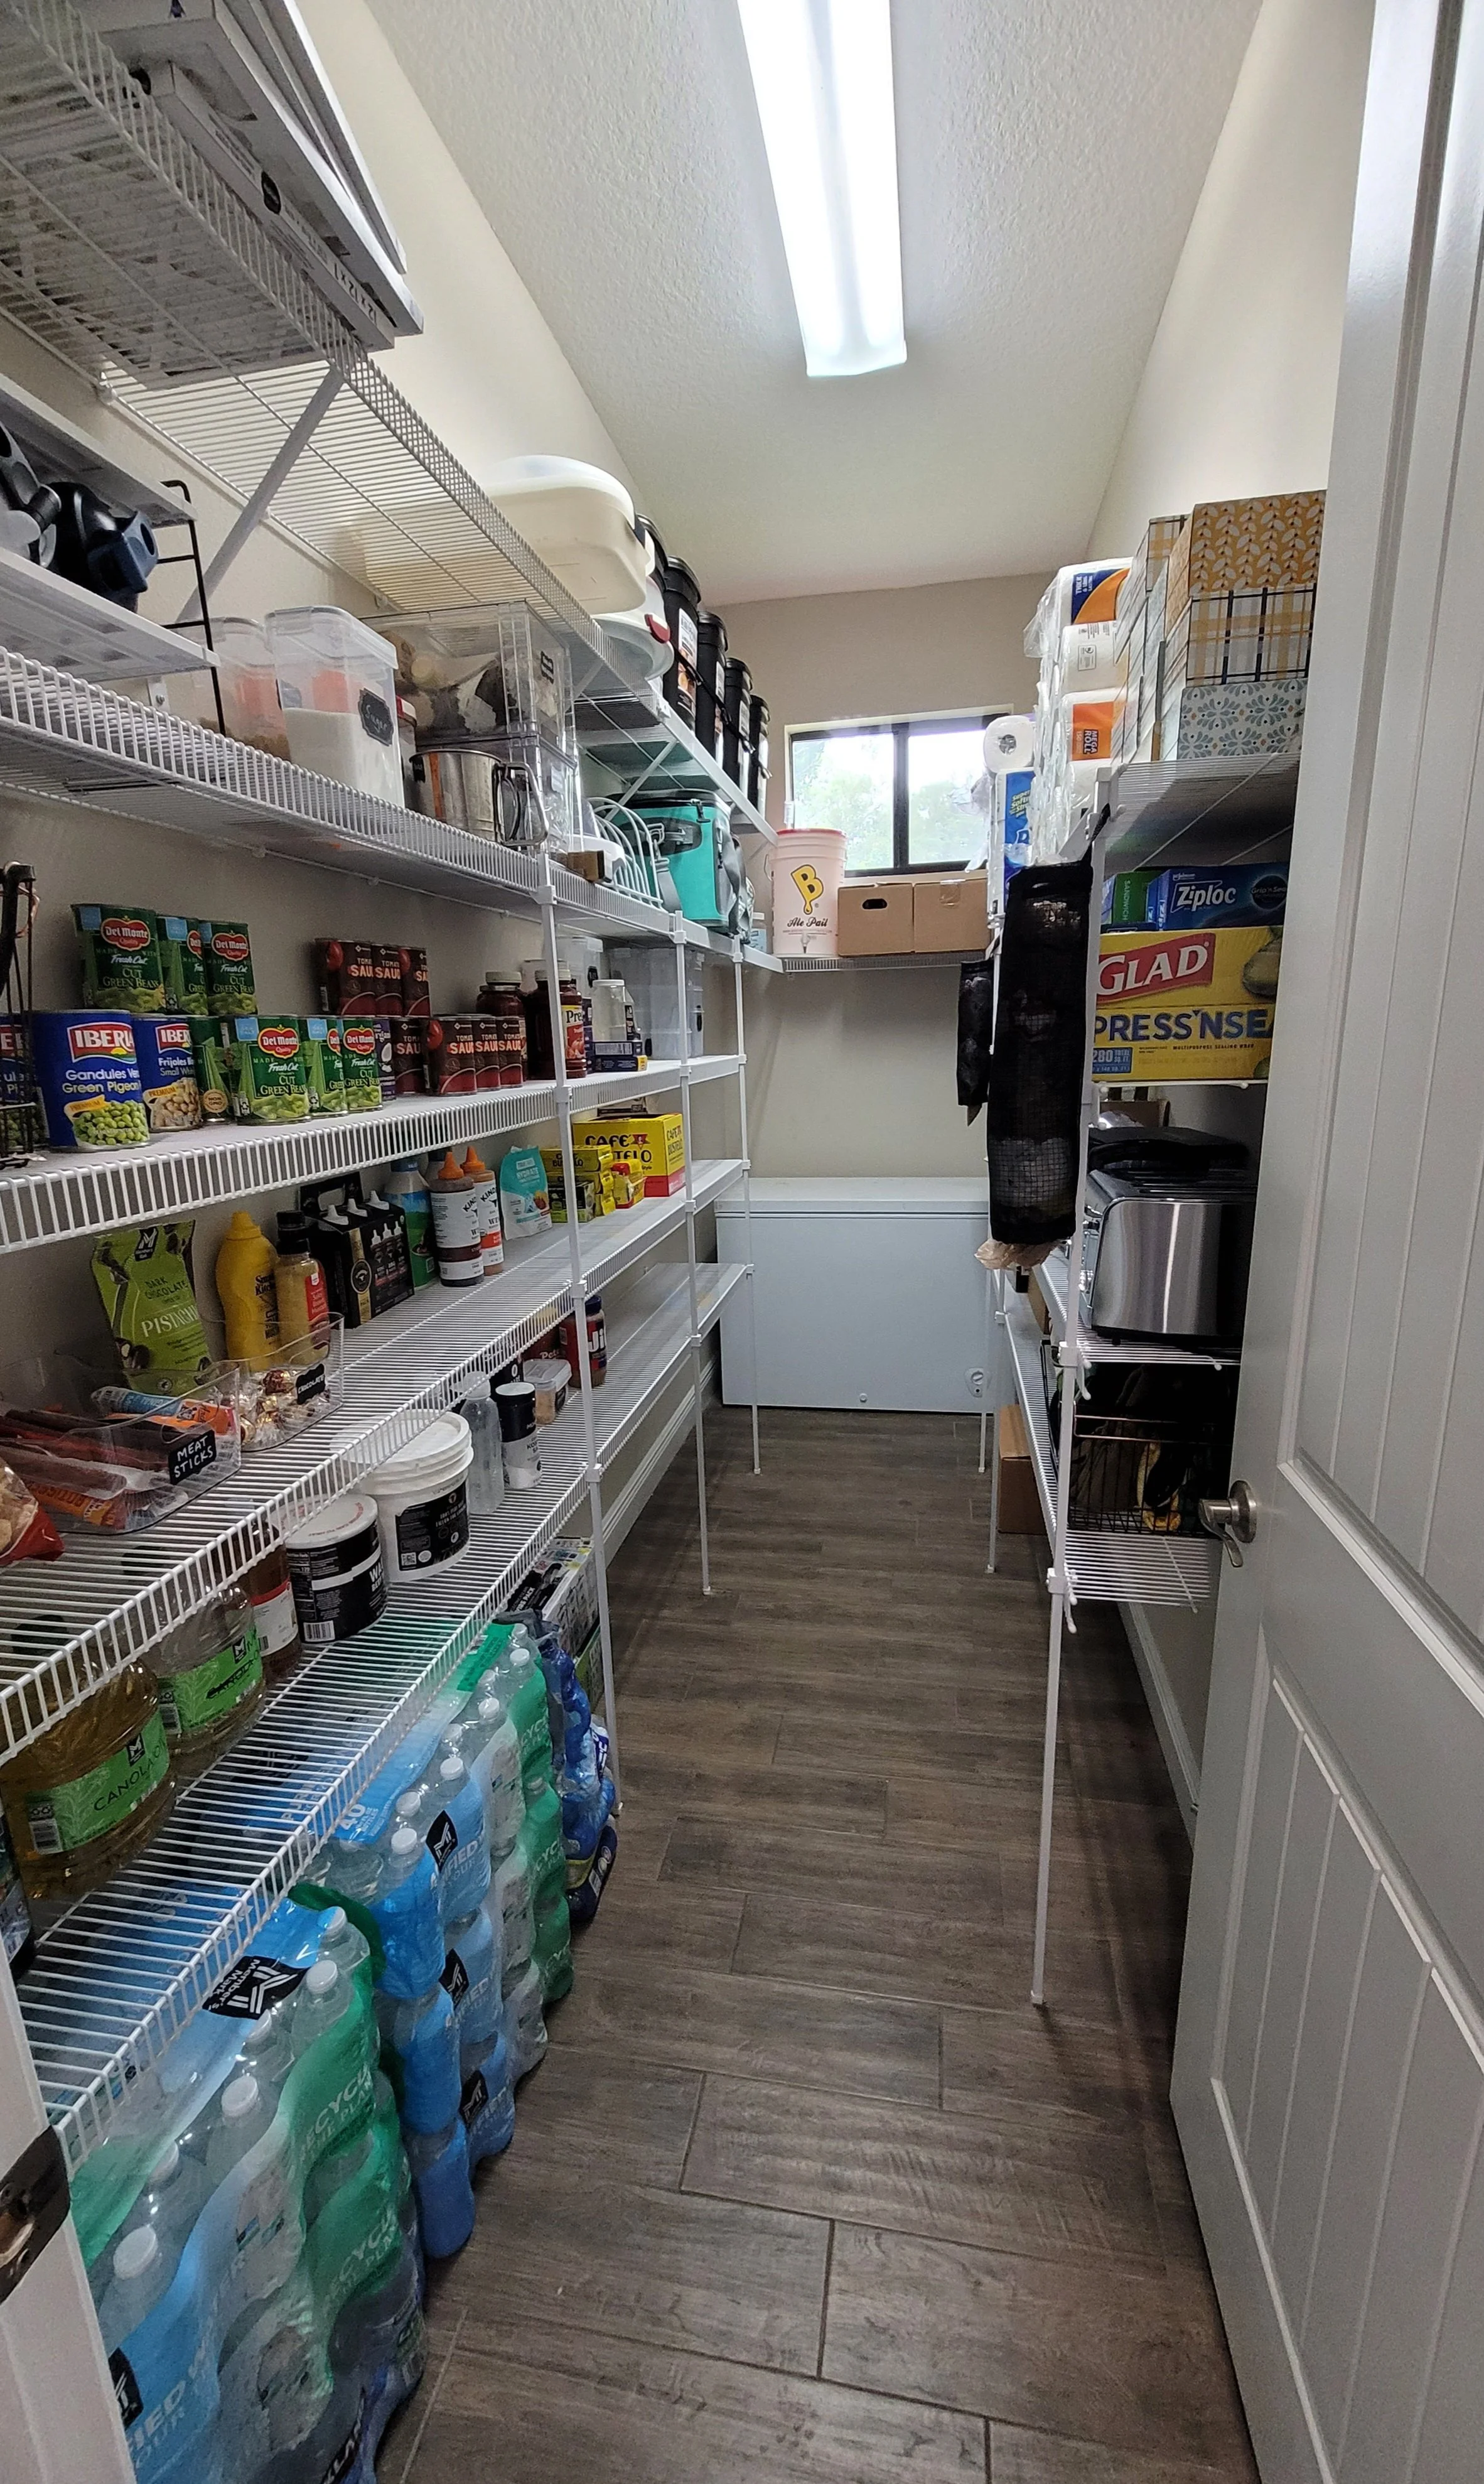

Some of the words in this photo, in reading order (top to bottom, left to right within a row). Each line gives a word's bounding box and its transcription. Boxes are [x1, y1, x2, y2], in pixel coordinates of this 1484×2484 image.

[1122, 880, 1131, 921] SANDWICH
[1177, 884, 1236, 912] Ziploc
[787, 917, 804, 927] Ale
[806, 917, 829, 927] Pail
[104, 926, 121, 936] Del
[121, 927, 148, 938] Monte
[215, 939, 228, 949] Del
[111, 954, 132, 963] Fresh
[132, 956, 148, 964] Cut
[122, 968, 142, 978] CUT
[1097, 944, 1209, 996] GLAD
[102, 976, 134, 986] GREEN
[230, 976, 244, 985] CUT
[213, 983, 239, 993] GREEN
[262, 1036, 276, 1045] Del
[347, 1035, 359, 1044] Del
[158, 1056, 186, 1067] Frijoles
[1093, 1049, 1113, 1063] 280
[160, 1067, 179, 1076] Small
[268, 1062, 288, 1073] Fresh
[288, 1062, 299, 1071] Cut
[360, 1069, 373, 1077] CUT
[65, 1069, 126, 1081] Gandules
[279, 1076, 295, 1084] CUT
[345, 1078, 368, 1086] GREEN
[62, 1083, 104, 1093] Green
[148, 1086, 176, 1097] PREMIUM
[260, 1085, 289, 1095] GREEN
[144, 1276, 168, 1289] DARK
[145, 1280, 188, 1300] CHOCOLATE
[177, 1435, 208, 1462] MEAT
[174, 1445, 213, 1478] STICKS
[94, 1758, 154, 1811] CANOLA
[212, 1969, 243, 1995] Mark
[212, 1958, 261, 2010] Member's
